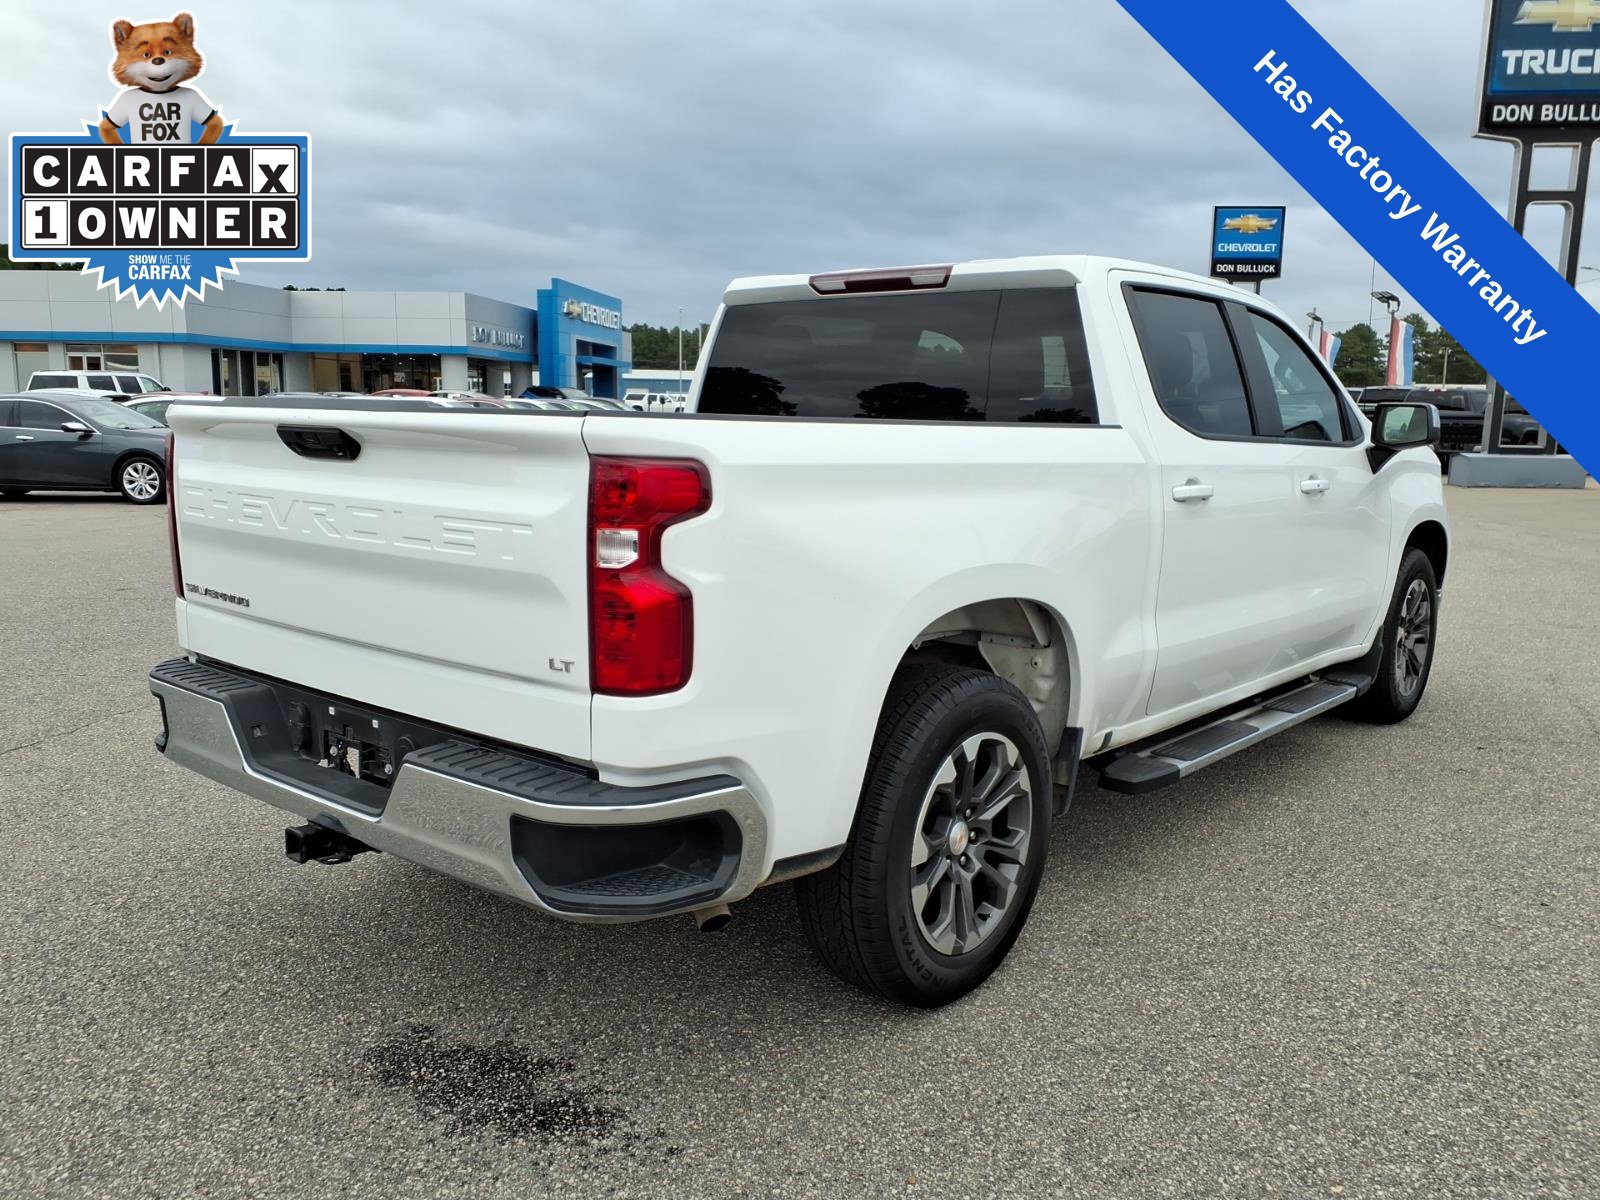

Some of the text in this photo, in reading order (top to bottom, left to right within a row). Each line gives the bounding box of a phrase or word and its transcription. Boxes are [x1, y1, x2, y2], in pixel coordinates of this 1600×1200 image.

[1492, 104, 1534, 122] DON
[1218, 243, 1277, 252] CHEVROLET
[1216, 264, 1276, 273] DON BULLUCK
[182, 485, 533, 561] CHEVROLET
[548, 656, 576, 674] LT
